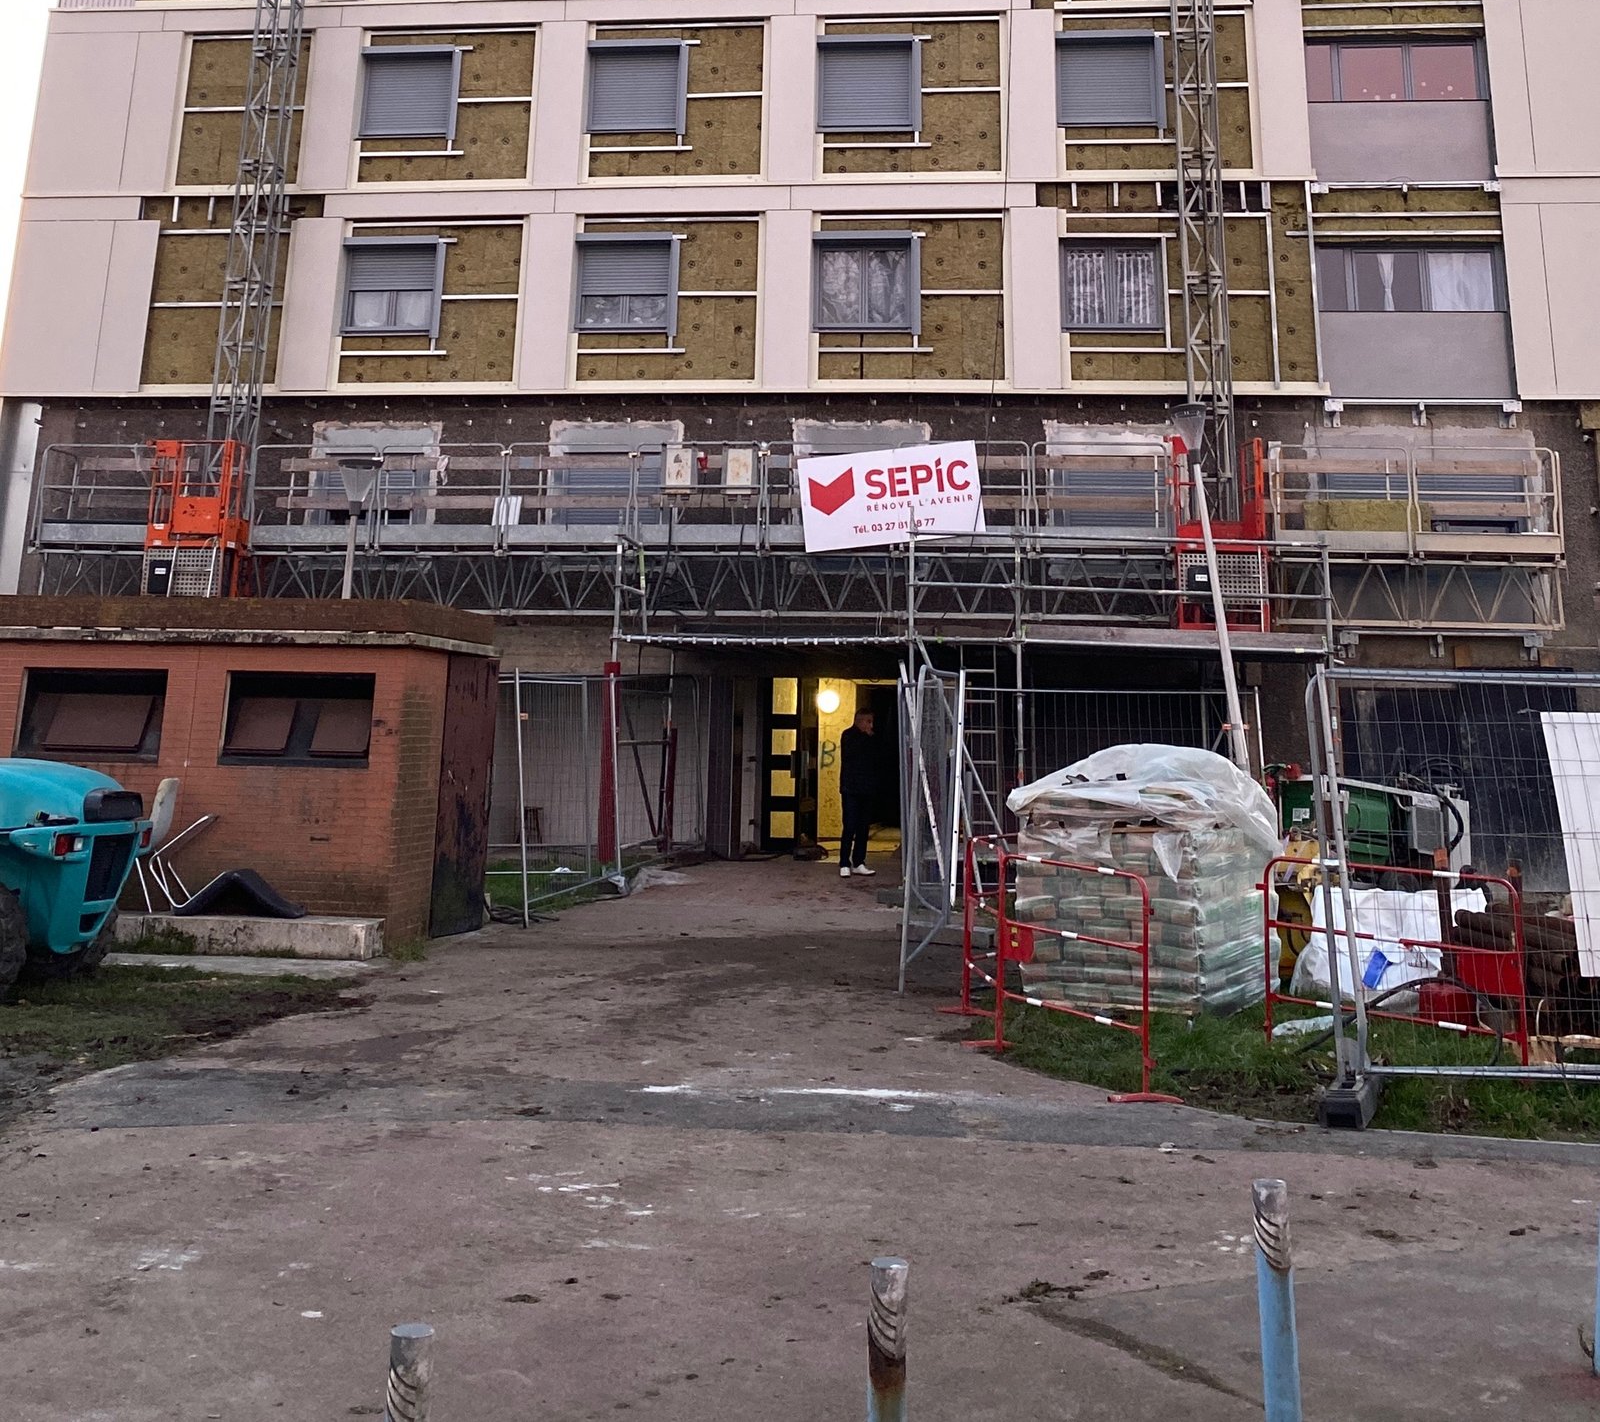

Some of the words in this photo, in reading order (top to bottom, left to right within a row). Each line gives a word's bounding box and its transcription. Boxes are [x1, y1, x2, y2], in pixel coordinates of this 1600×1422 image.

[866, 500, 912, 512] RÉNOVE
[919, 494, 973, 506] L'AVENIR
[853, 525, 869, 534] Tél.
[871, 523, 883, 532] 03
[885, 522, 895, 531] 27
[924, 518, 935, 527] 77
